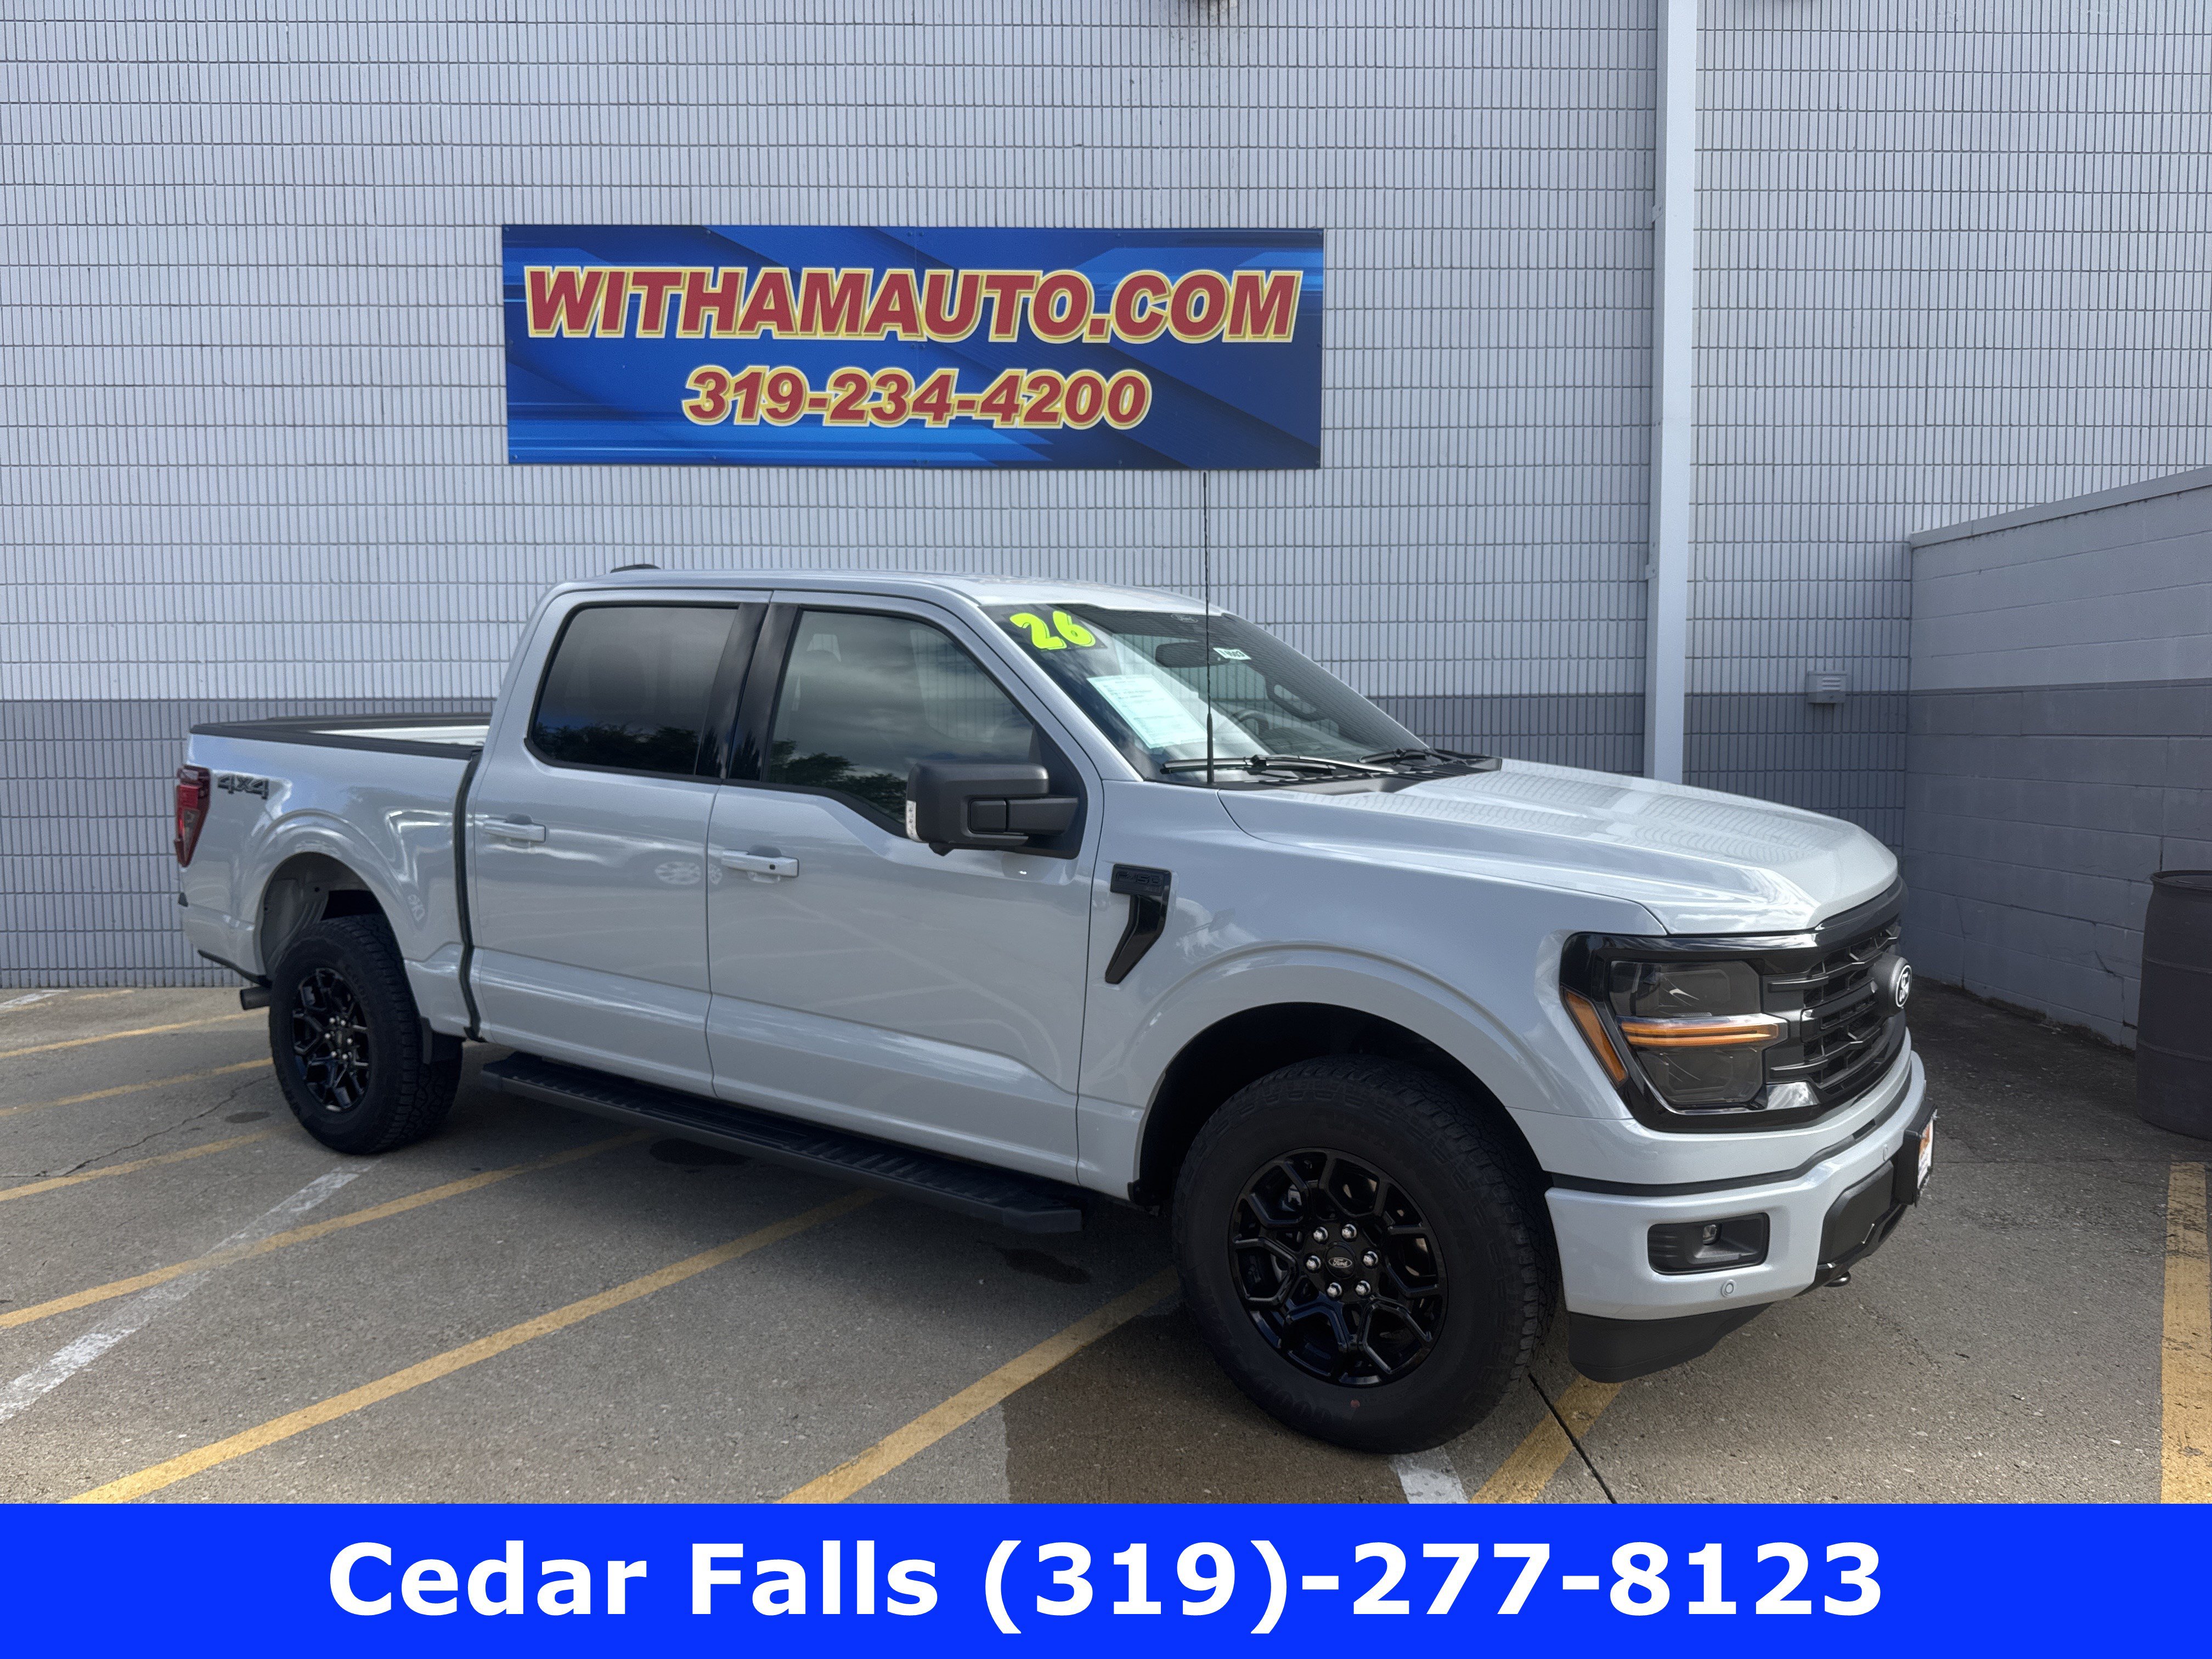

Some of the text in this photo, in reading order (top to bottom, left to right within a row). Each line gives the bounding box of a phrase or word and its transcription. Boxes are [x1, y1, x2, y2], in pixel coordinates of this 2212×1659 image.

[524, 266, 1303, 343] WITHAMAUTO.COM
[682, 365, 1153, 430] 319-234-4200
[1010, 611, 1096, 650] 26
